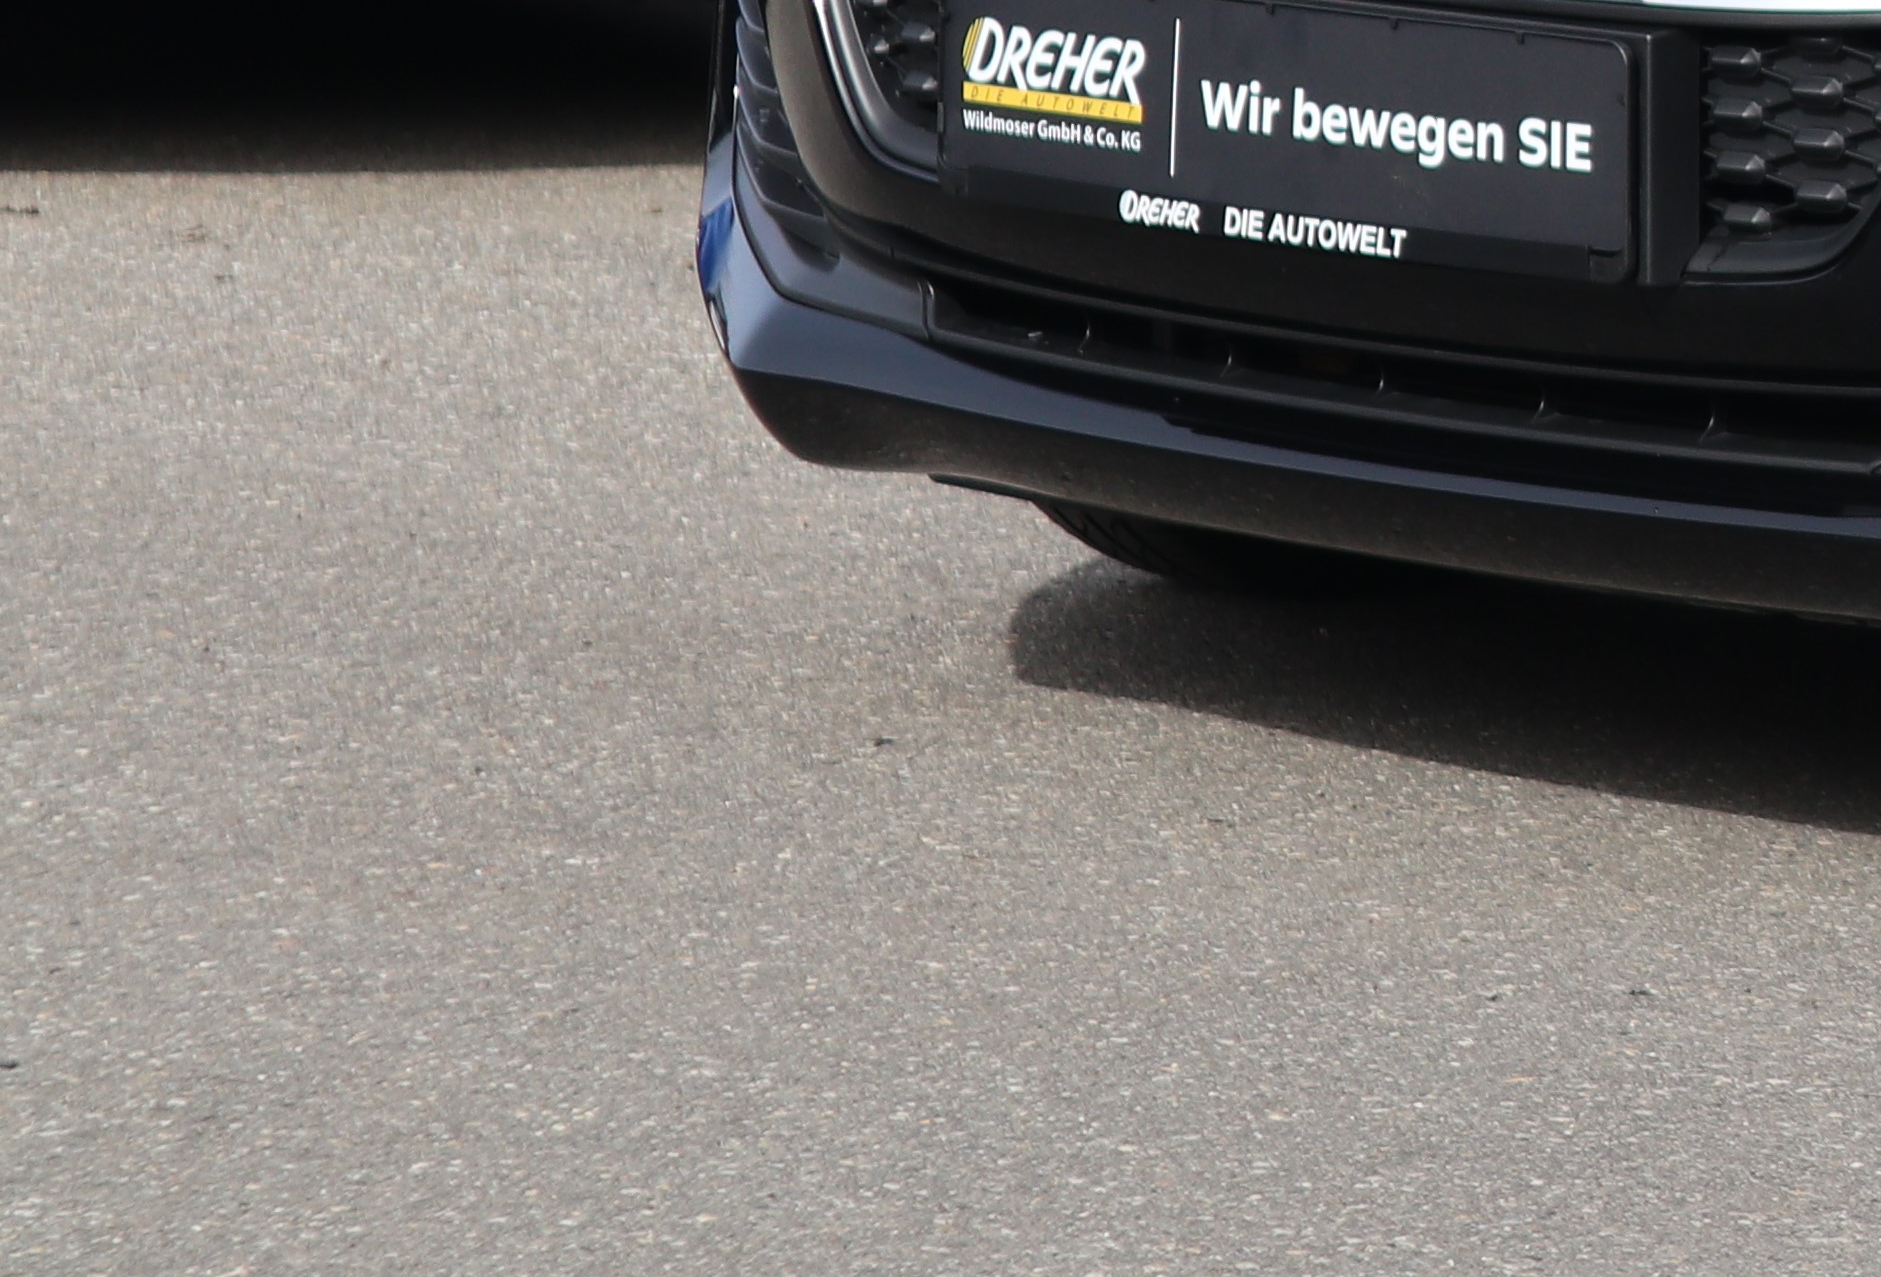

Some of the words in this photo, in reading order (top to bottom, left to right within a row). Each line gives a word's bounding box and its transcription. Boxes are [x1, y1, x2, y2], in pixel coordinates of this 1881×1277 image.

[962, 16, 1145, 105] DREHER
[963, 109, 1034, 138] Wildmoser
[1037, 119, 1081, 144] GmbH
[1083, 126, 1095, 144] &
[1096, 128, 1118, 149] Co.
[1121, 129, 1141, 152] KG
[971, 85, 1004, 102] DIE
[1021, 93, 1137, 118] AUTOWELT
[1201, 79, 1280, 136] Wir
[1293, 87, 1504, 169] bewegen
[1518, 117, 1592, 173] SIE
[1119, 190, 1200, 233] DREHER
[1224, 205, 1264, 242] DIE
[1267, 213, 1407, 259] AUTOWELT
